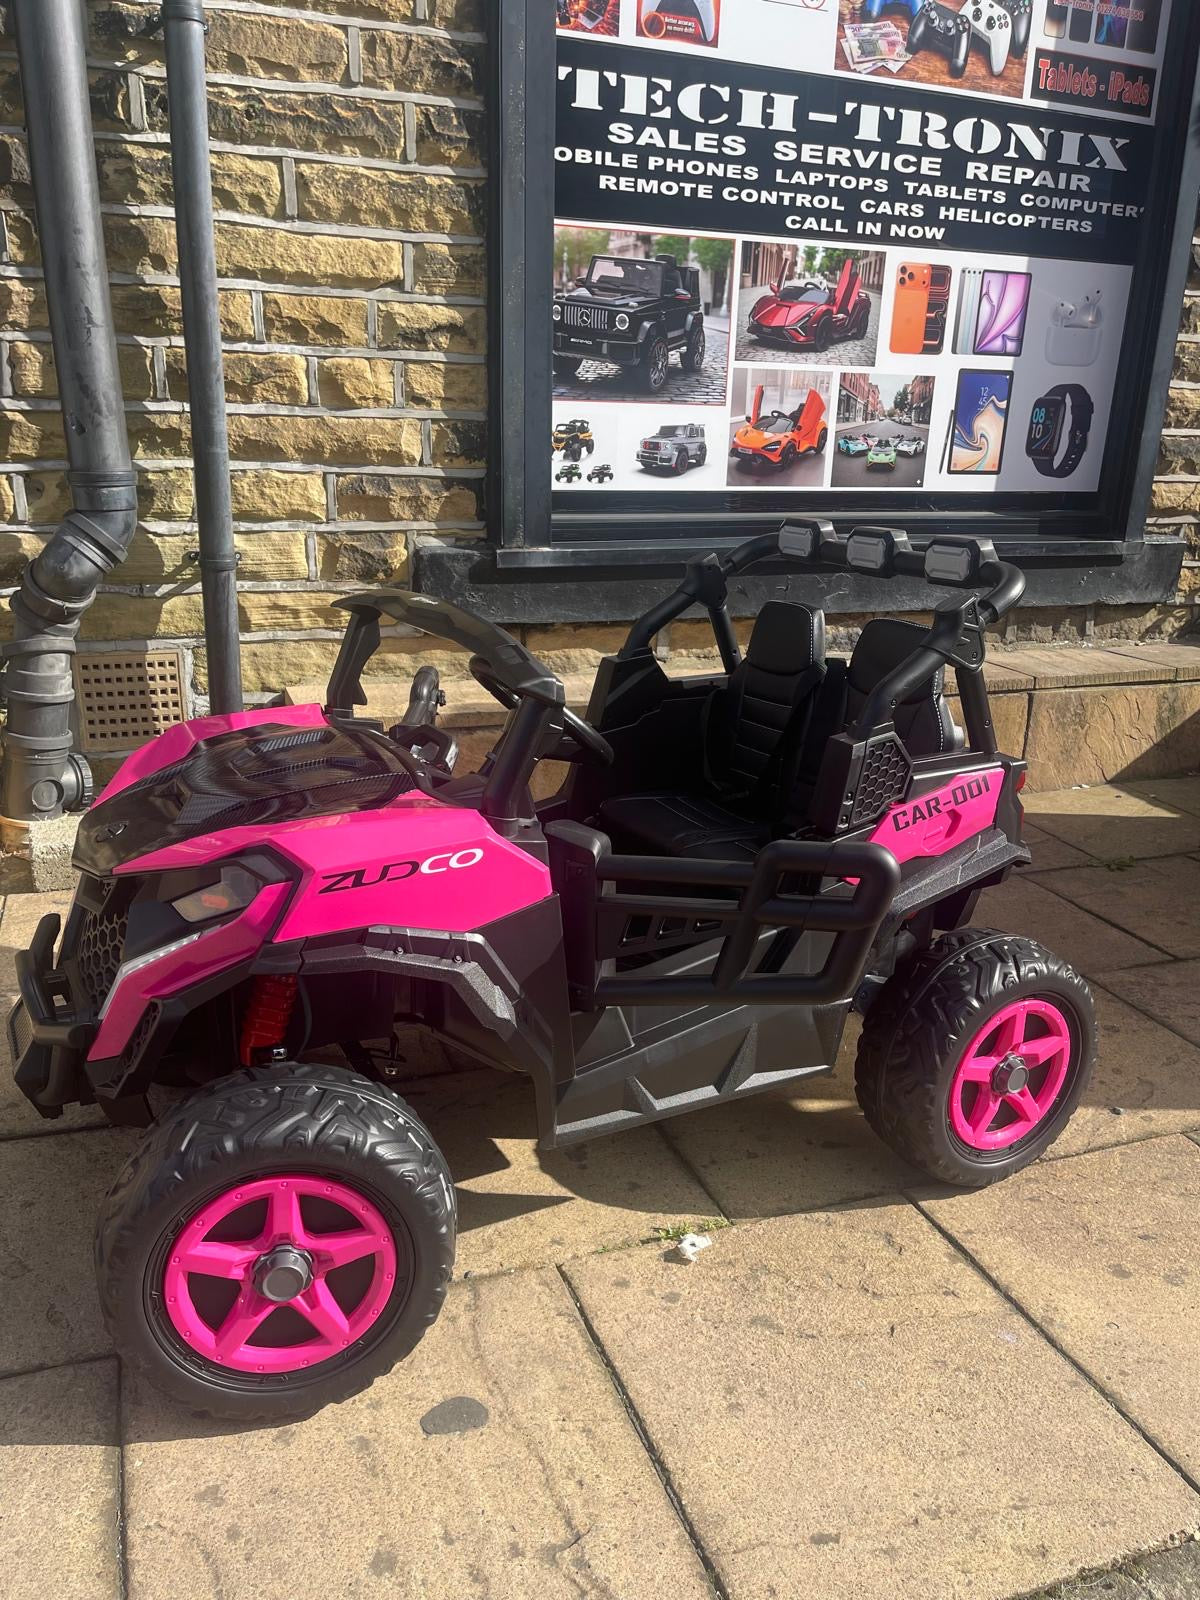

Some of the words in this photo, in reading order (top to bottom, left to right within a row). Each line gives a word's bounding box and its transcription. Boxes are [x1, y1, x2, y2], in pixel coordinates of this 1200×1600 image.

[1039, 58, 1097, 97] Tablets
[1107, 70, 1150, 106] iPads
[557, 65, 1130, 172] TECH-TRONIX
[554, 146, 638, 169] OBILE
[648, 156, 759, 181] PHONES
[775, 168, 889, 193] LAPTOPS
[903, 181, 1006, 204] TABLETS
[1020, 193, 1145, 218] COMPUTER
[607, 122, 747, 156] SALES
[773, 140, 942, 177] SERVICE
[965, 161, 1091, 193] REPAIR
[599, 174, 713, 199] REMOTE
[722, 186, 845, 211] CONTROL
[860, 198, 925, 218] CARS
[938, 206, 1093, 233] HELICOPTERS
[785, 215, 848, 233] CALL
[856, 221, 882, 235] IN
[889, 223, 945, 240] NOW
[1032, 424, 1043, 438] 10
[1033, 408, 1045, 423] 08
[892, 774, 990, 832] CAR-001
[318, 848, 484, 894] ZUDCO
